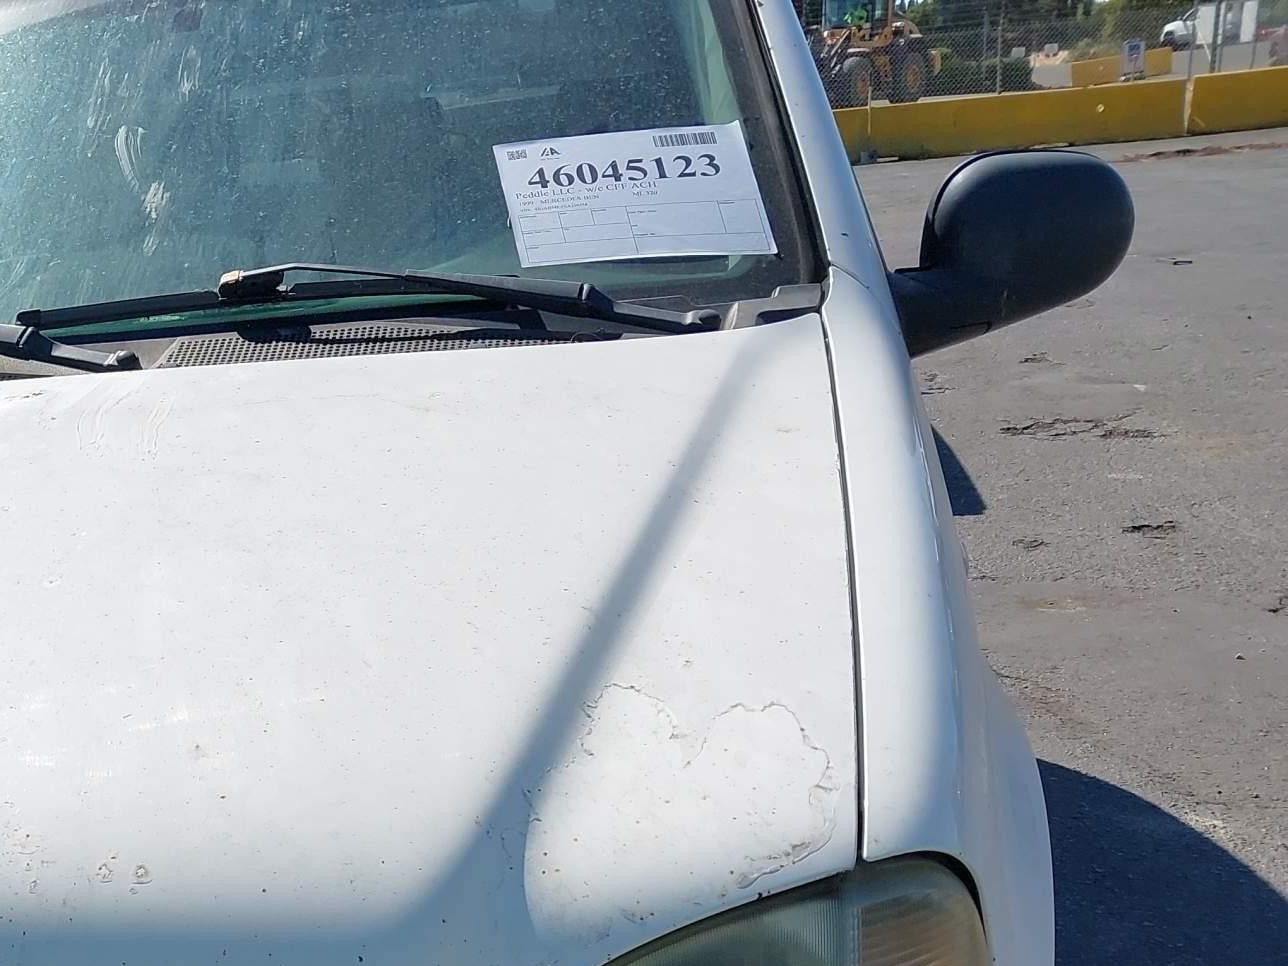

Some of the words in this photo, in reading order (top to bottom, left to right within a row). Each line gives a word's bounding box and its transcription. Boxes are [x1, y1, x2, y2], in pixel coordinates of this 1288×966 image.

[527, 153, 721, 189] 46045123
[515, 189, 549, 200] Peddle
[552, 187, 575, 196] LLC
[632, 180, 657, 189] ACH
